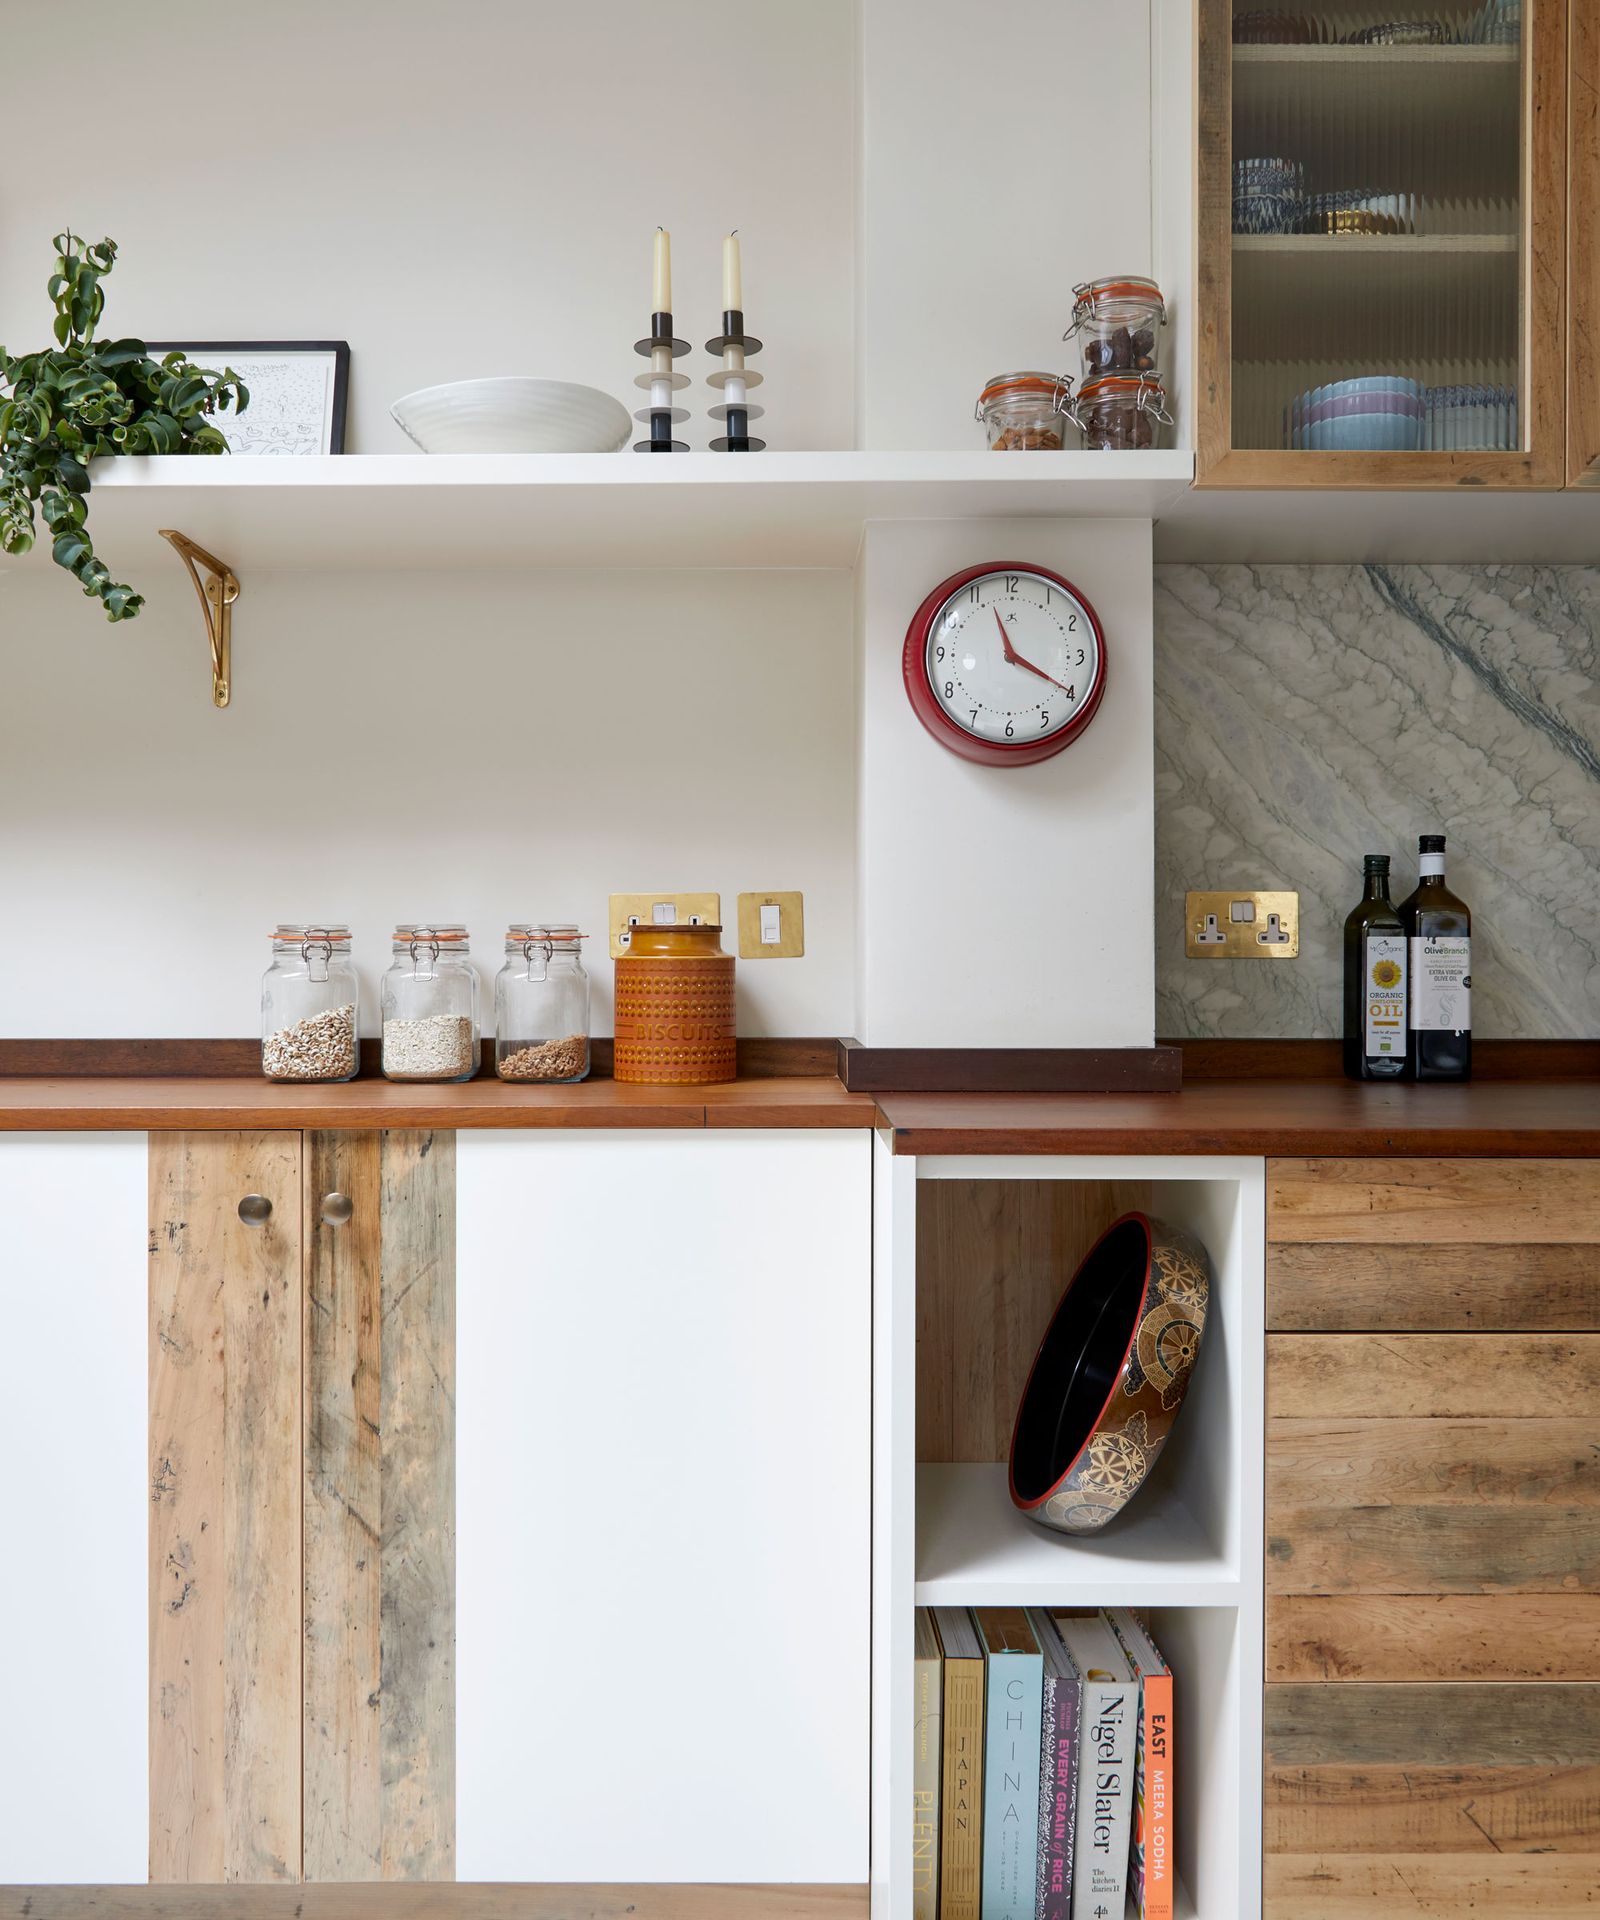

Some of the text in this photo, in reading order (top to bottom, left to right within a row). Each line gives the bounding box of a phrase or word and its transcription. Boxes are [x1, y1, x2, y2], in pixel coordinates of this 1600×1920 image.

[1005, 576, 1019, 593] 12
[970, 586, 980, 603] 11
[943, 611, 957, 629] 10
[1068, 614, 1076, 632] 2
[936, 646, 945, 663] 9
[1075, 649, 1085, 666] 3
[944, 681, 954, 699] 8
[1066, 684, 1075, 702] 4
[969, 710, 978, 728] 7
[1040, 711, 1049, 729] 5
[1005, 720, 1014, 737] 6
[1424, 946, 1468, 955] OliveBranch
[1369, 1004, 1403, 1017] OIL
[636, 1023, 721, 1041] BISCUITS
[1003, 1680, 1024, 1823] CHINA
[956, 1736, 968, 1829] JAPAN
[1090, 1694, 1124, 1854] Nigel Slater
[1152, 1714, 1166, 1880] EAST MEERA SODHA
[1049, 1739, 1069, 1893] EVERY GRAIN of RICE
[913, 1791, 933, 1894] PLENTY
[1092, 1868, 1105, 1876] The
[1091, 1885, 1112, 1893] diaries
[1093, 1904, 1108, 1919] 4th
